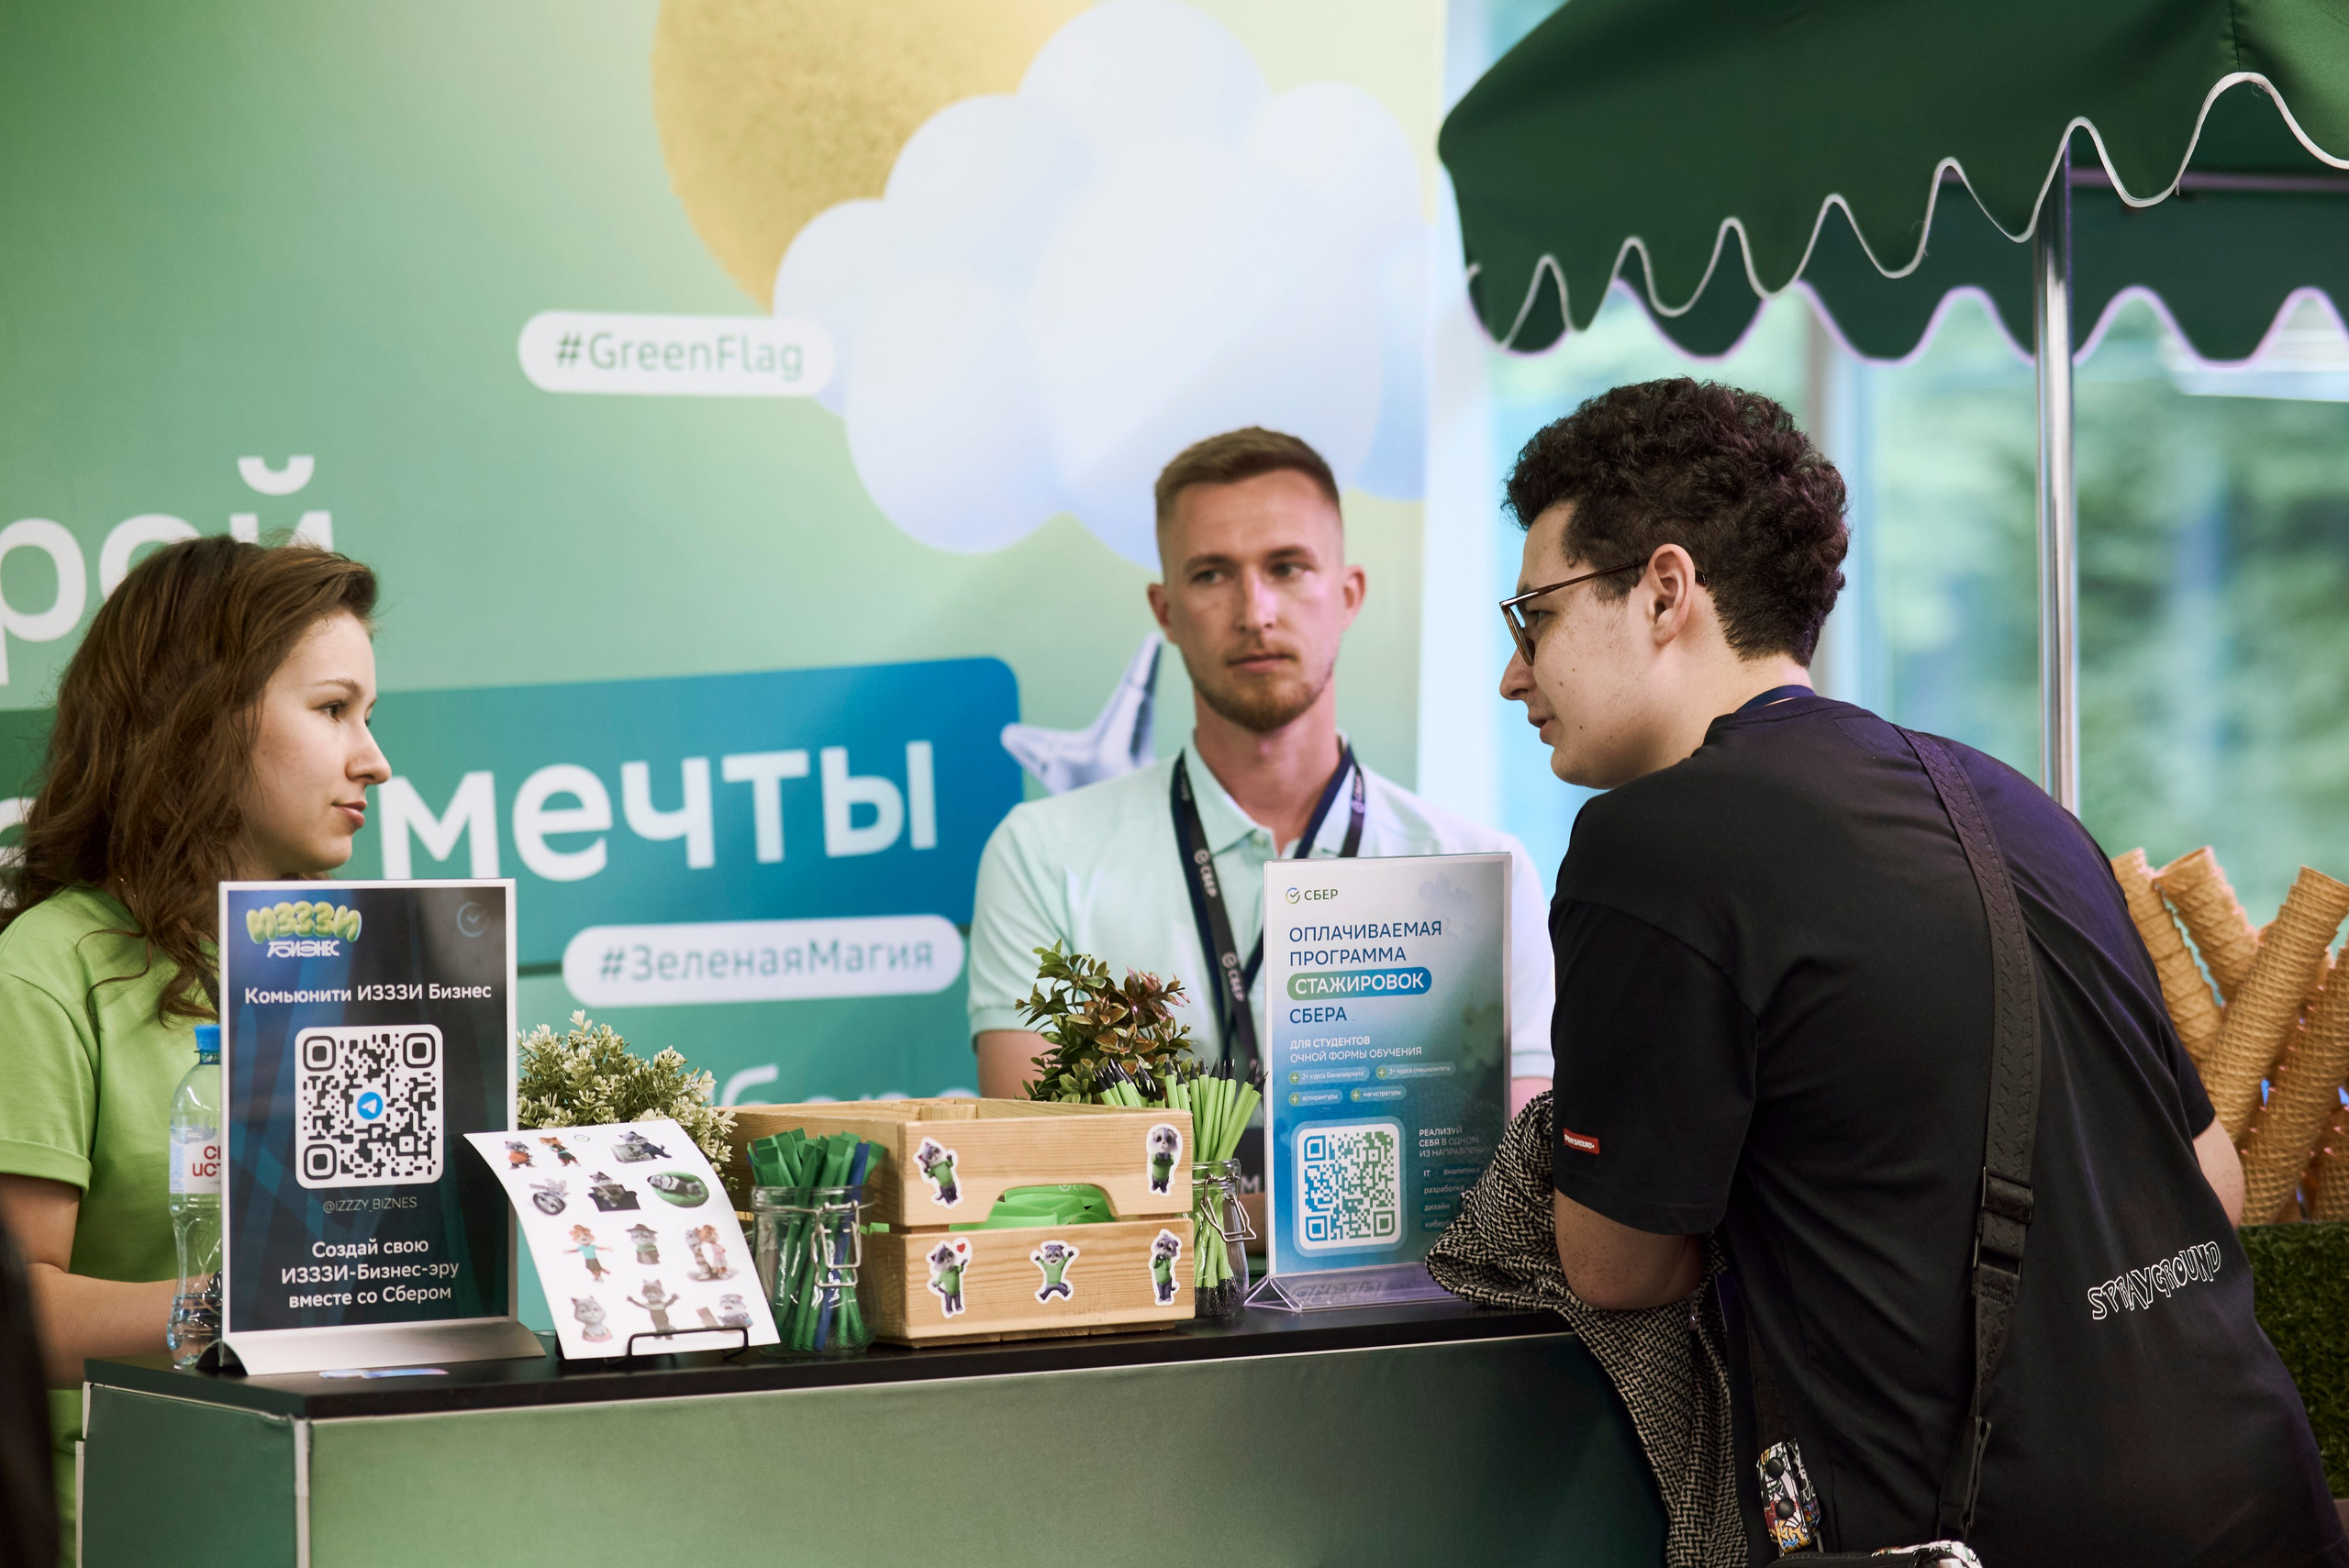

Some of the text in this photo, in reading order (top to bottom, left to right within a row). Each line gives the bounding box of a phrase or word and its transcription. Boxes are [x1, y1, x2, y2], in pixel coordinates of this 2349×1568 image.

[555, 331, 805, 382] #GreenFlag
[378, 740, 937, 881] мечты
[1304, 888, 1339, 901] СБЕР
[246, 901, 362, 945] ИЗЗЗИ
[1289, 920, 1442, 942] ОПЛАЧИВАЕМАЯ
[598, 937, 935, 983] #ЗеленаяМагия
[1289, 946, 1407, 966] ПРОГРАММА
[1294, 973, 1425, 995] СТАЖИРОВОК
[245, 983, 492, 1005] Комьюнити ИЗЗЗИ Бизнес
[1289, 1006, 1348, 1024] СБЕРА
[1290, 1036, 1371, 1051] ДЛЯ СТУДЕНТОВ
[1290, 1047, 1422, 1063] ОЧНОЙ ФОРМЫ ОБУЧЕНИЯ
[1309, 1073, 1326, 1081] курса
[1301, 1094, 1338, 1102] аспирантуры
[1363, 1089, 1402, 1098] магистратуры
[1419, 1126, 1463, 1137] РЕАЛИЗУЙ
[1419, 1136, 1479, 1147] СЕБЯ В ОДНОМ
[1419, 1149, 1431, 1158] ИЗ
[1423, 1169, 1431, 1177] IT
[1423, 1184, 1465, 1195] разработка
[323, 1196, 417, 1214] @IZZZY_BIZNES
[1424, 1202, 1450, 1211] дизайн
[312, 1238, 429, 1259] Создай свою
[281, 1262, 460, 1284] ИЗЗЗИ-Бизнес-эру
[2087, 1240, 2221, 1320] SPRAYGROUND
[289, 1284, 451, 1308] вместе со Сбером
